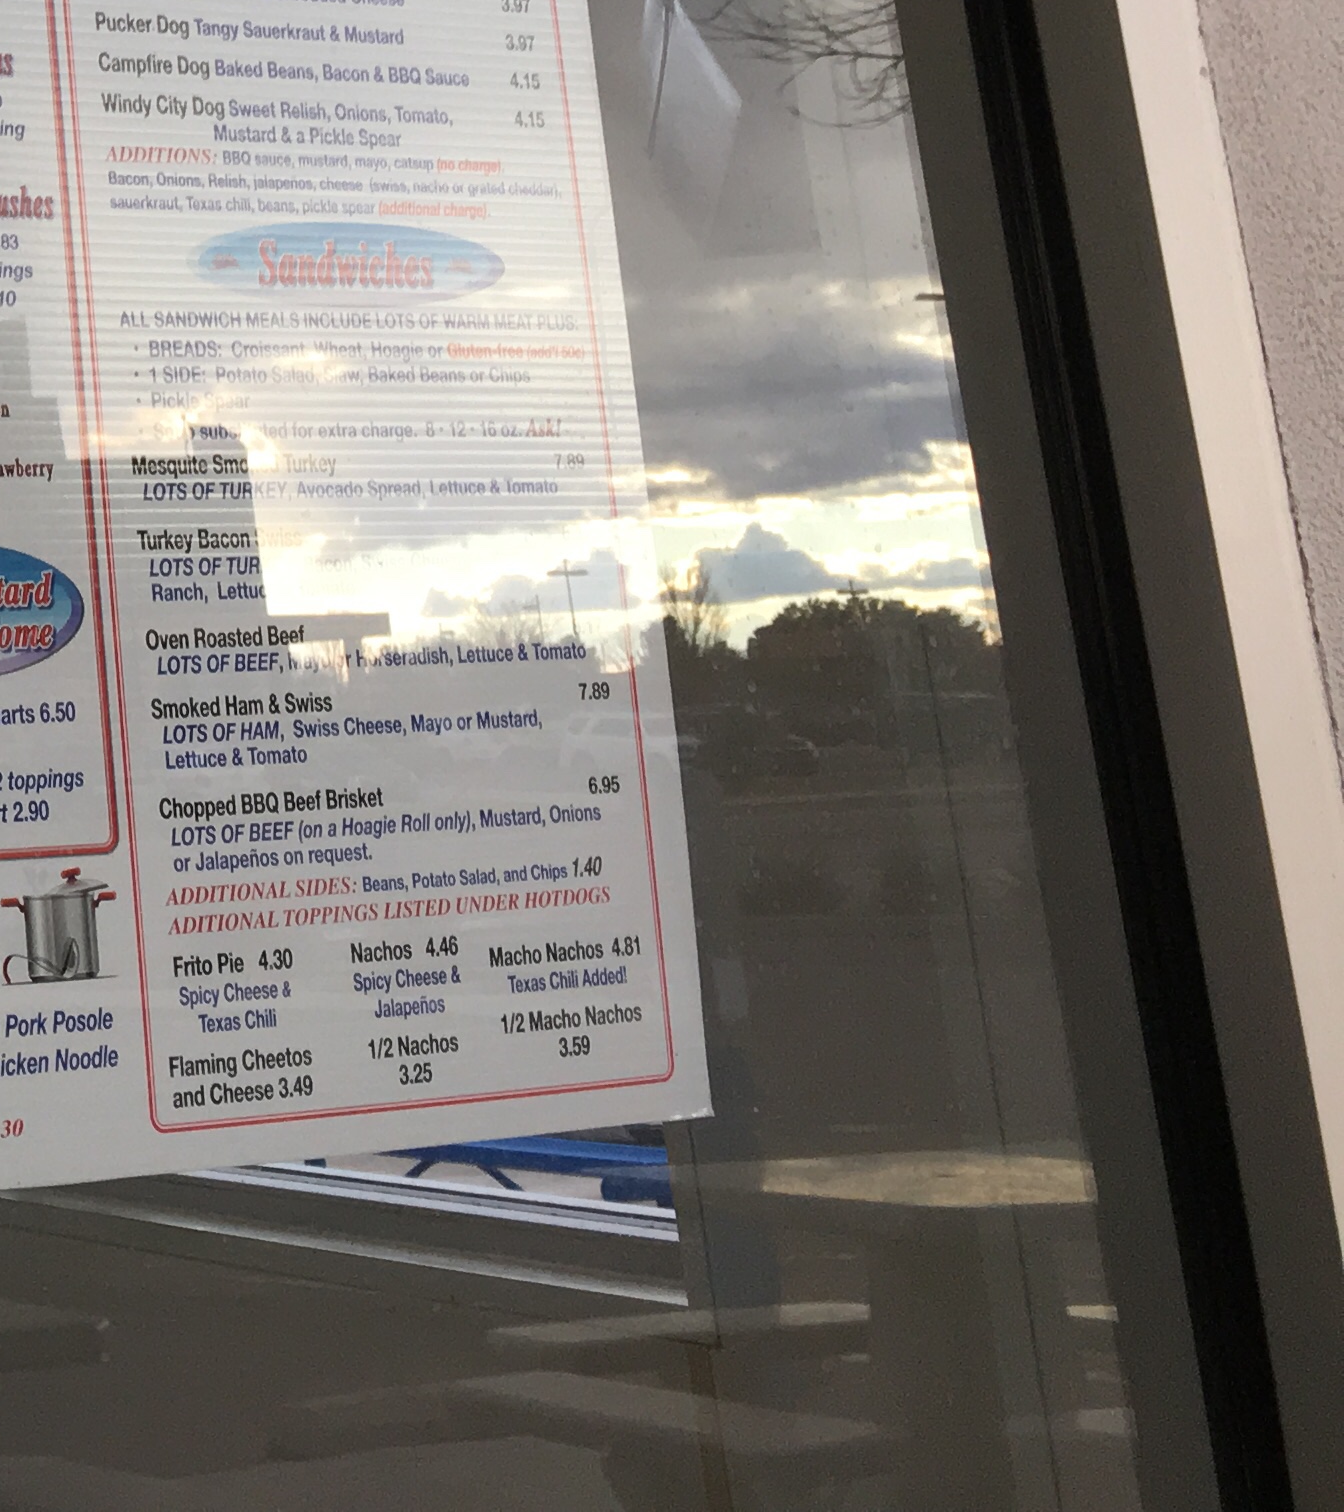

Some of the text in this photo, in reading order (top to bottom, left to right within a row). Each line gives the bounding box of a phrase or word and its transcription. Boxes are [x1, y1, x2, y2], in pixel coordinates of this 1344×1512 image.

[151, 692, 332, 719] Smoked Ham & Swiss
[173, 948, 292, 977] Frito Pie 4.30
[56, 1045, 118, 1072] Noodle
[368, 1034, 458, 1059] 1/2 Nachos
[399, 1062, 432, 1085] 3.25
